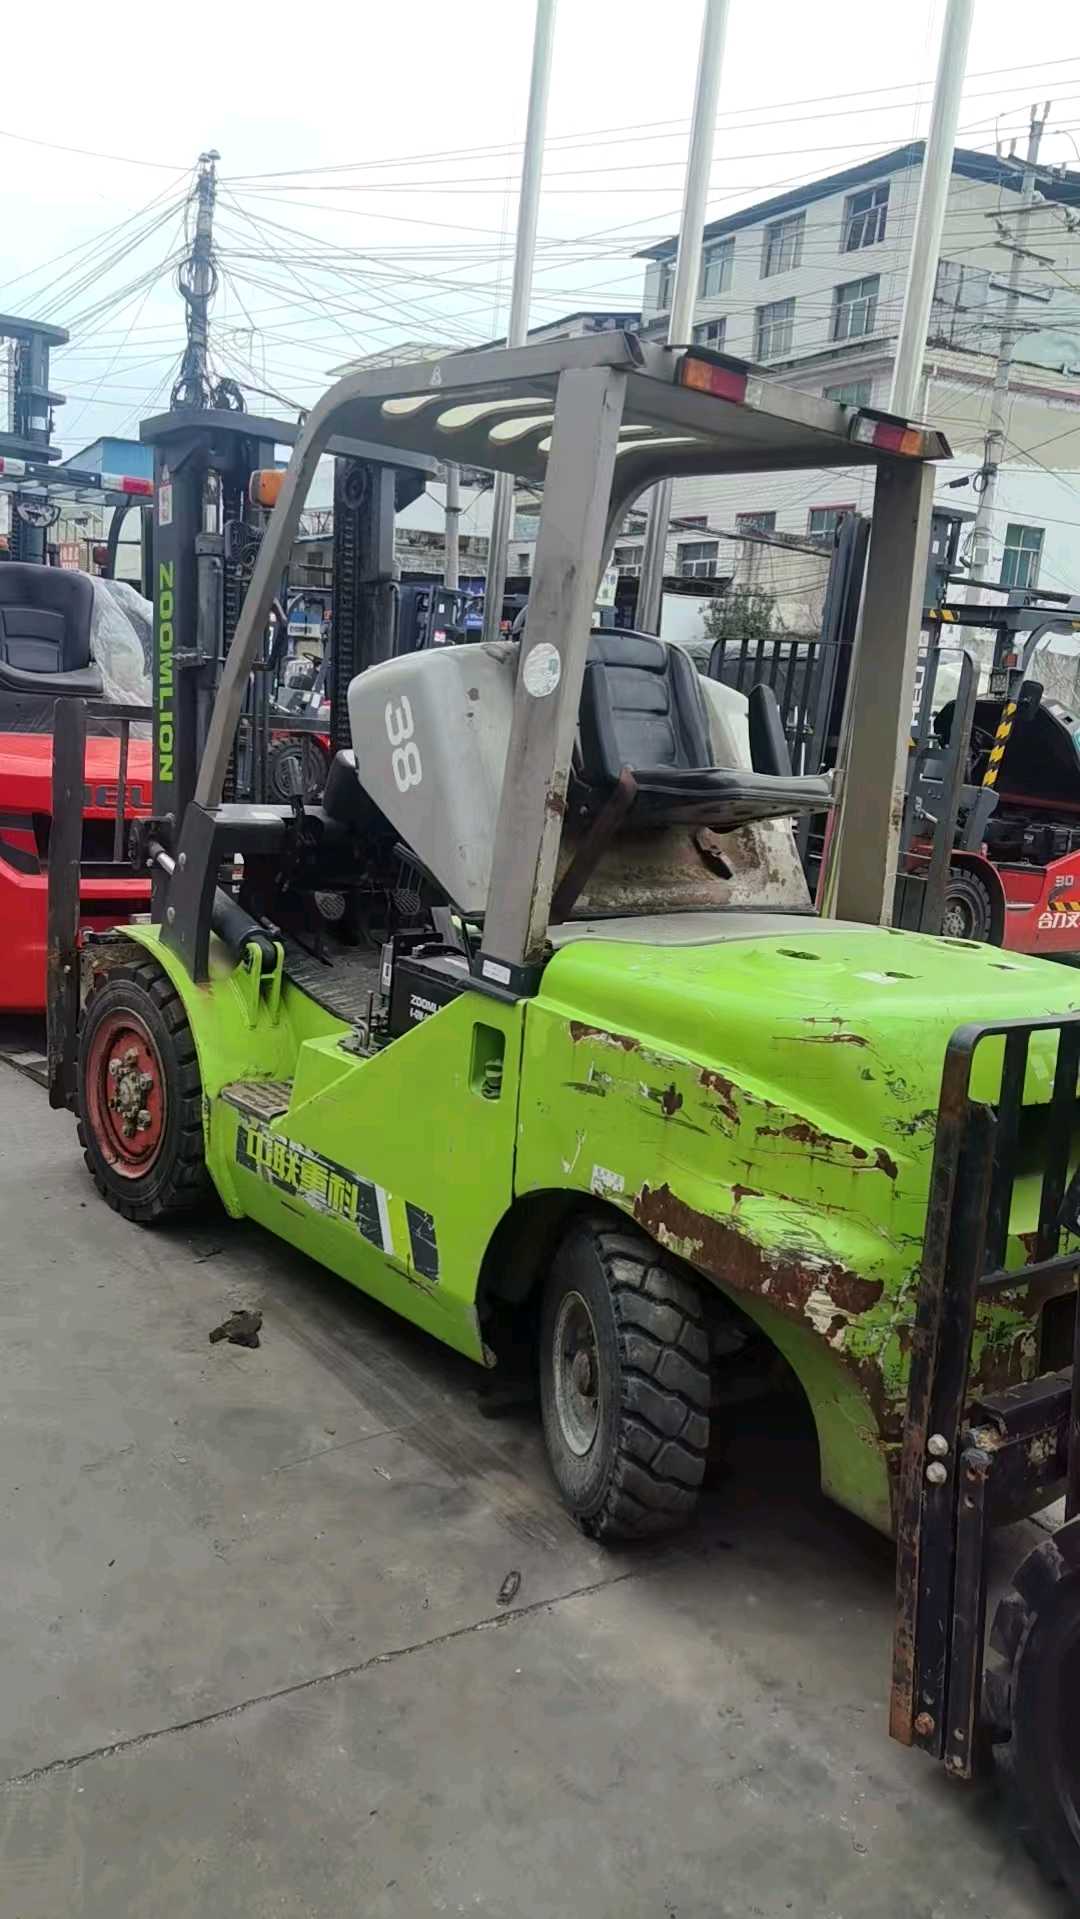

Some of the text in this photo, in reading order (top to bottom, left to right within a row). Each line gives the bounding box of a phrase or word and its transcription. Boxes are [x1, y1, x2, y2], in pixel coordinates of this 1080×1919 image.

[159, 560, 174, 781] ZOOMLION
[384, 695, 422, 793] 38
[1055, 875, 1074, 887] 30
[1038, 911, 1080, 929] 合力叉
